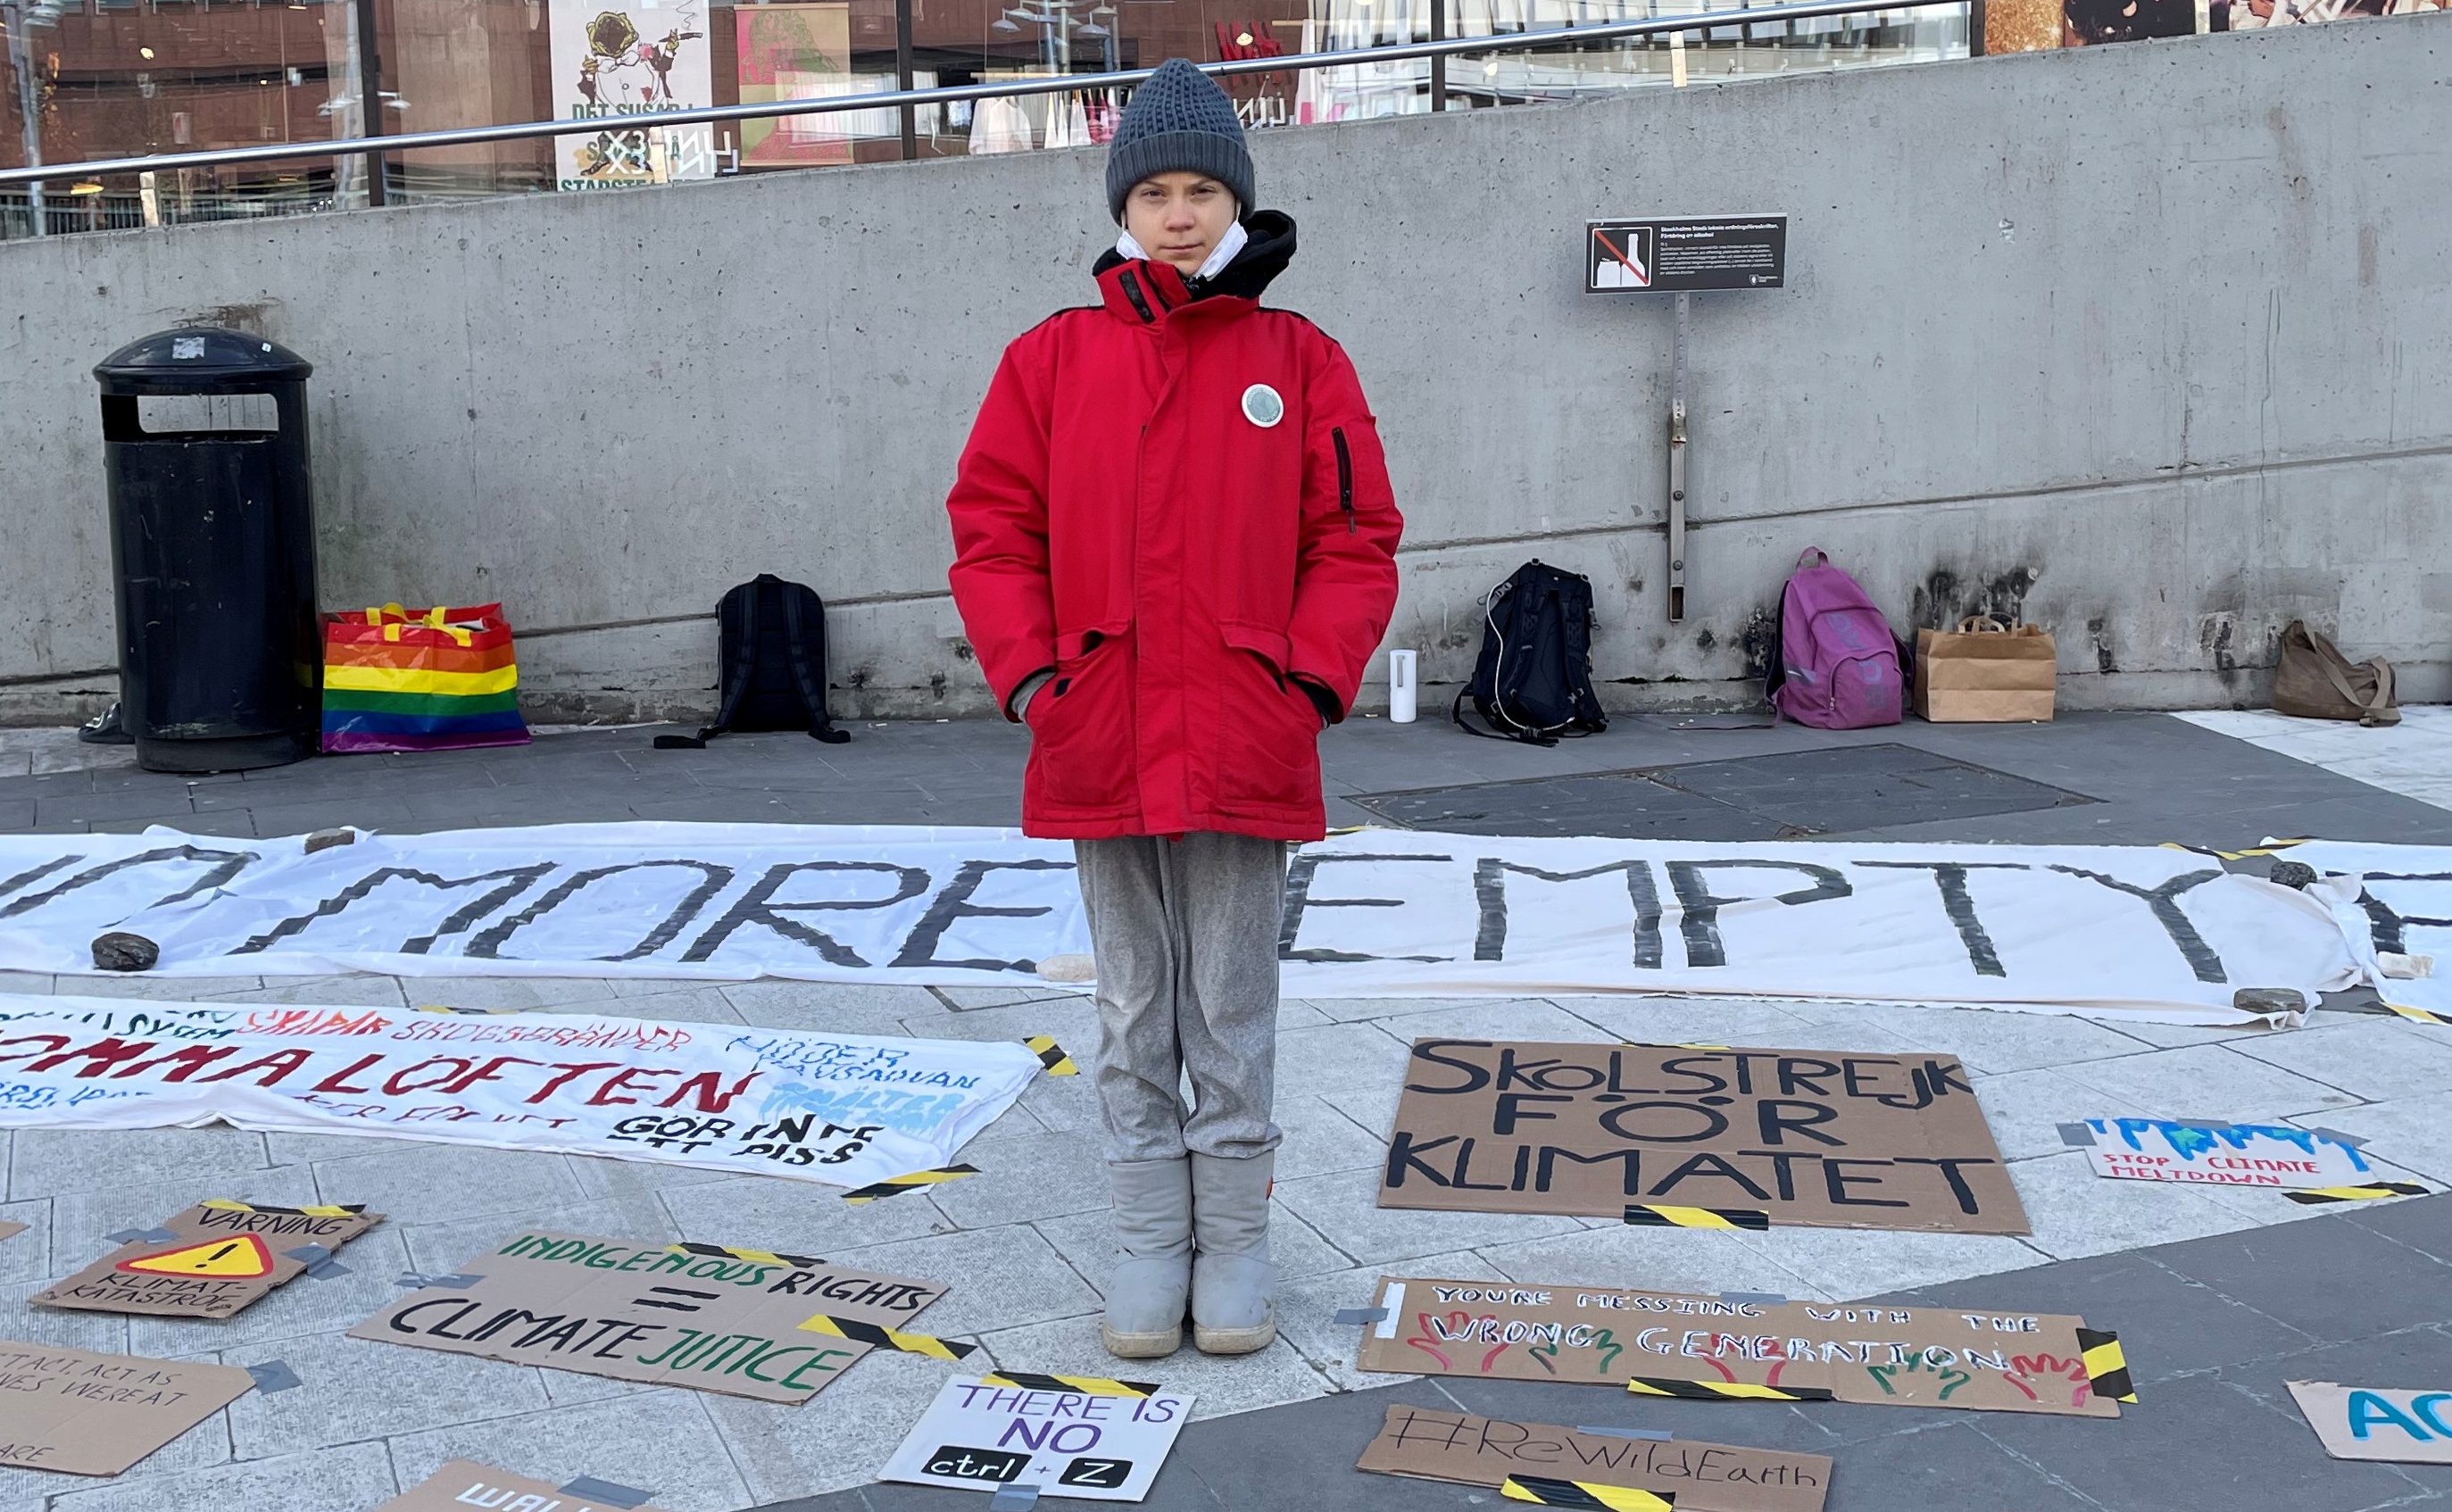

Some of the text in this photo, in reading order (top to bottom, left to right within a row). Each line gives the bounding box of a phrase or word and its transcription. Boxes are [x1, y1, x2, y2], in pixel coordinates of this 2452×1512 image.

[224, 859, 1078, 972] MORE
[1278, 852, 2228, 984] EMPTY
[0, 1032, 315, 1087] OMMA
[310, 1053, 765, 1113] LÖFTEN
[1404, 1040, 1975, 1109] SKOLSTREJK
[613, 1115, 736, 1138] GÖR
[1493, 1093, 1848, 1145] FÖR
[729, 1142, 862, 1165] PISS
[2103, 1153, 2321, 1175] STOP CLIMATE
[1385, 1131, 1996, 1215] KLIMATET
[2111, 1165, 2282, 1185] MELTDOWN
[197, 1208, 356, 1235] VARNING
[497, 1235, 935, 1311] INDIGENOUS RIGHTS
[66, 1284, 243, 1307] KATASTROF
[1805, 1306, 1911, 1324] WITH
[1961, 1315, 2041, 1333] THE
[390, 1298, 854, 1390] CLIMATE JUTICE
[1432, 1316, 2012, 1371] WRONG GENERATION
[80, 1363, 137, 1381] ACT
[138, 1370, 182, 1385] AS
[956, 1384, 1180, 1423] THERE IS
[997, 1417, 1102, 1454] NO
[930, 1453, 1016, 1480] ctrl
[1071, 1461, 1116, 1484] Z
